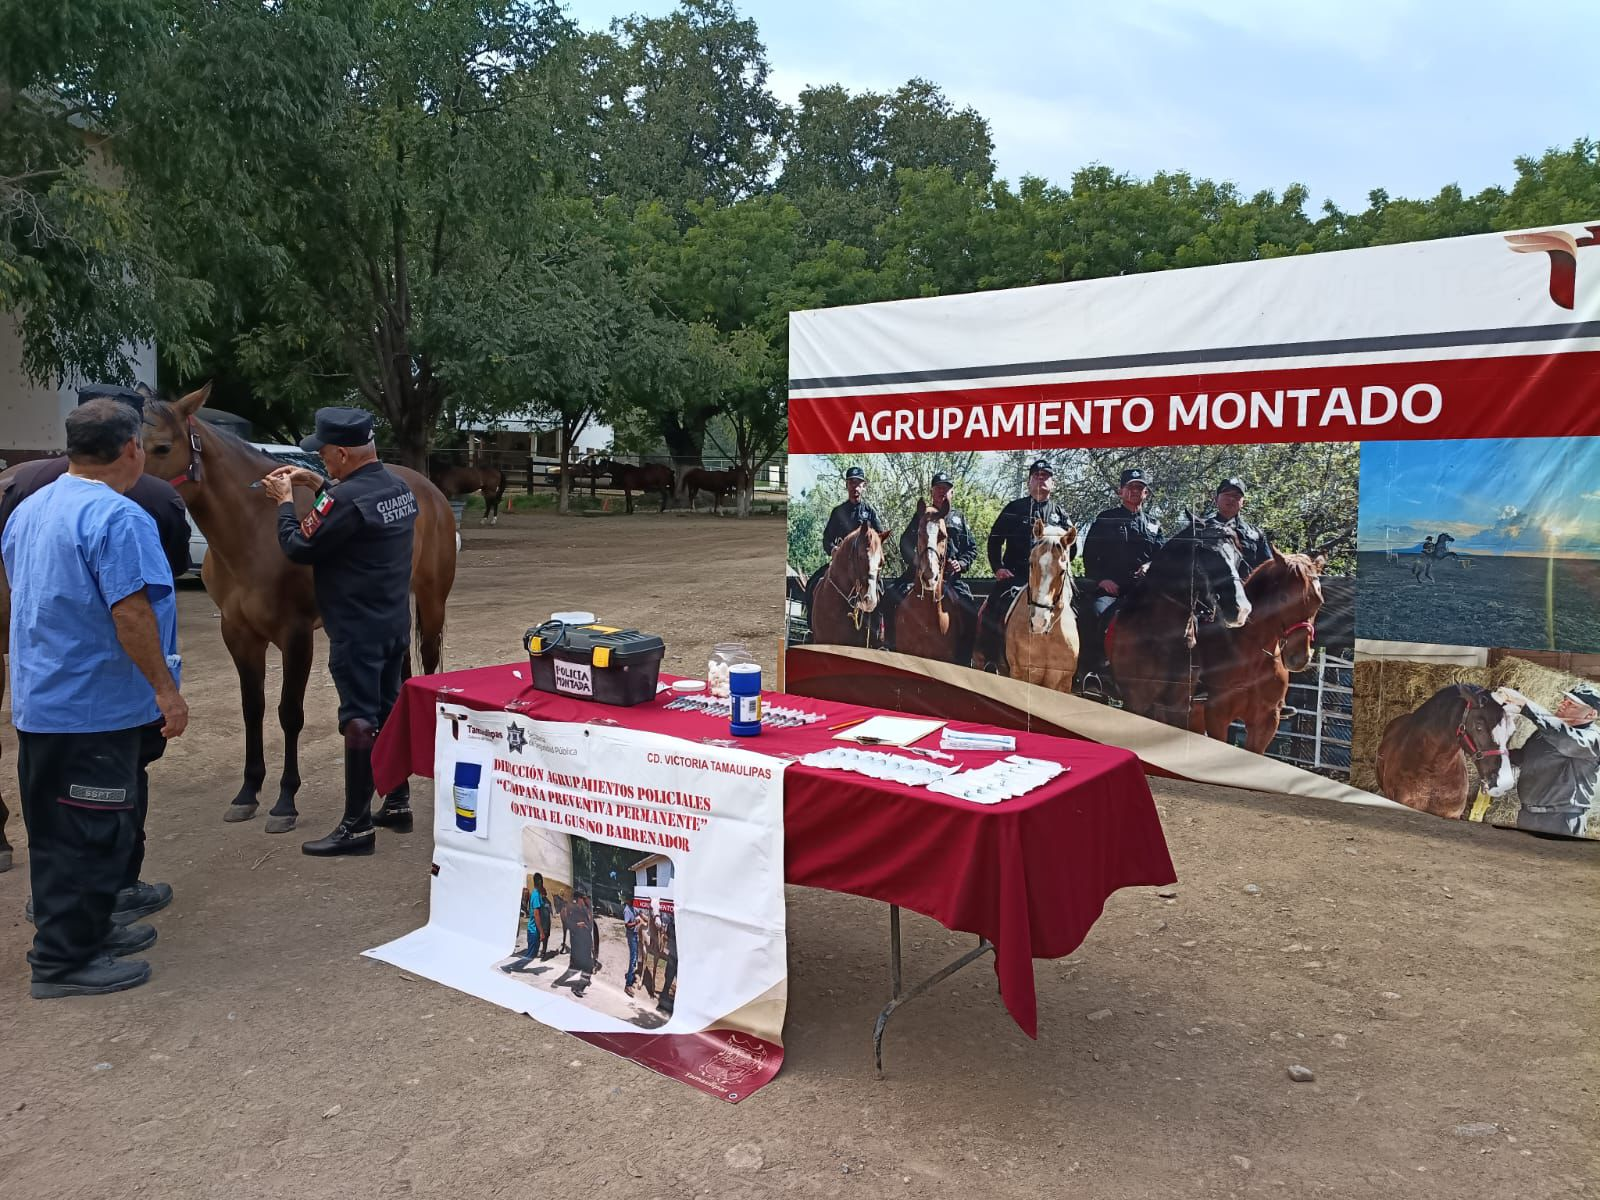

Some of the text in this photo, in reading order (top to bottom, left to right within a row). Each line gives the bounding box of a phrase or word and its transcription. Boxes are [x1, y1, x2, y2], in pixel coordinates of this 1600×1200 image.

[848, 382, 1443, 442] AGRUPAMIENTO MONTADO
[376, 491, 415, 513] GUARDIA
[383, 504, 417, 524] ESTATAL
[556, 676, 591, 692] MONTADA
[647, 753, 772, 780] CD. VICTORIA TAMAULIPAS
[637, 787, 711, 811] POLICIALES
[550, 810, 563, 825] EL
[606, 823, 690, 852] BARRENADOR
